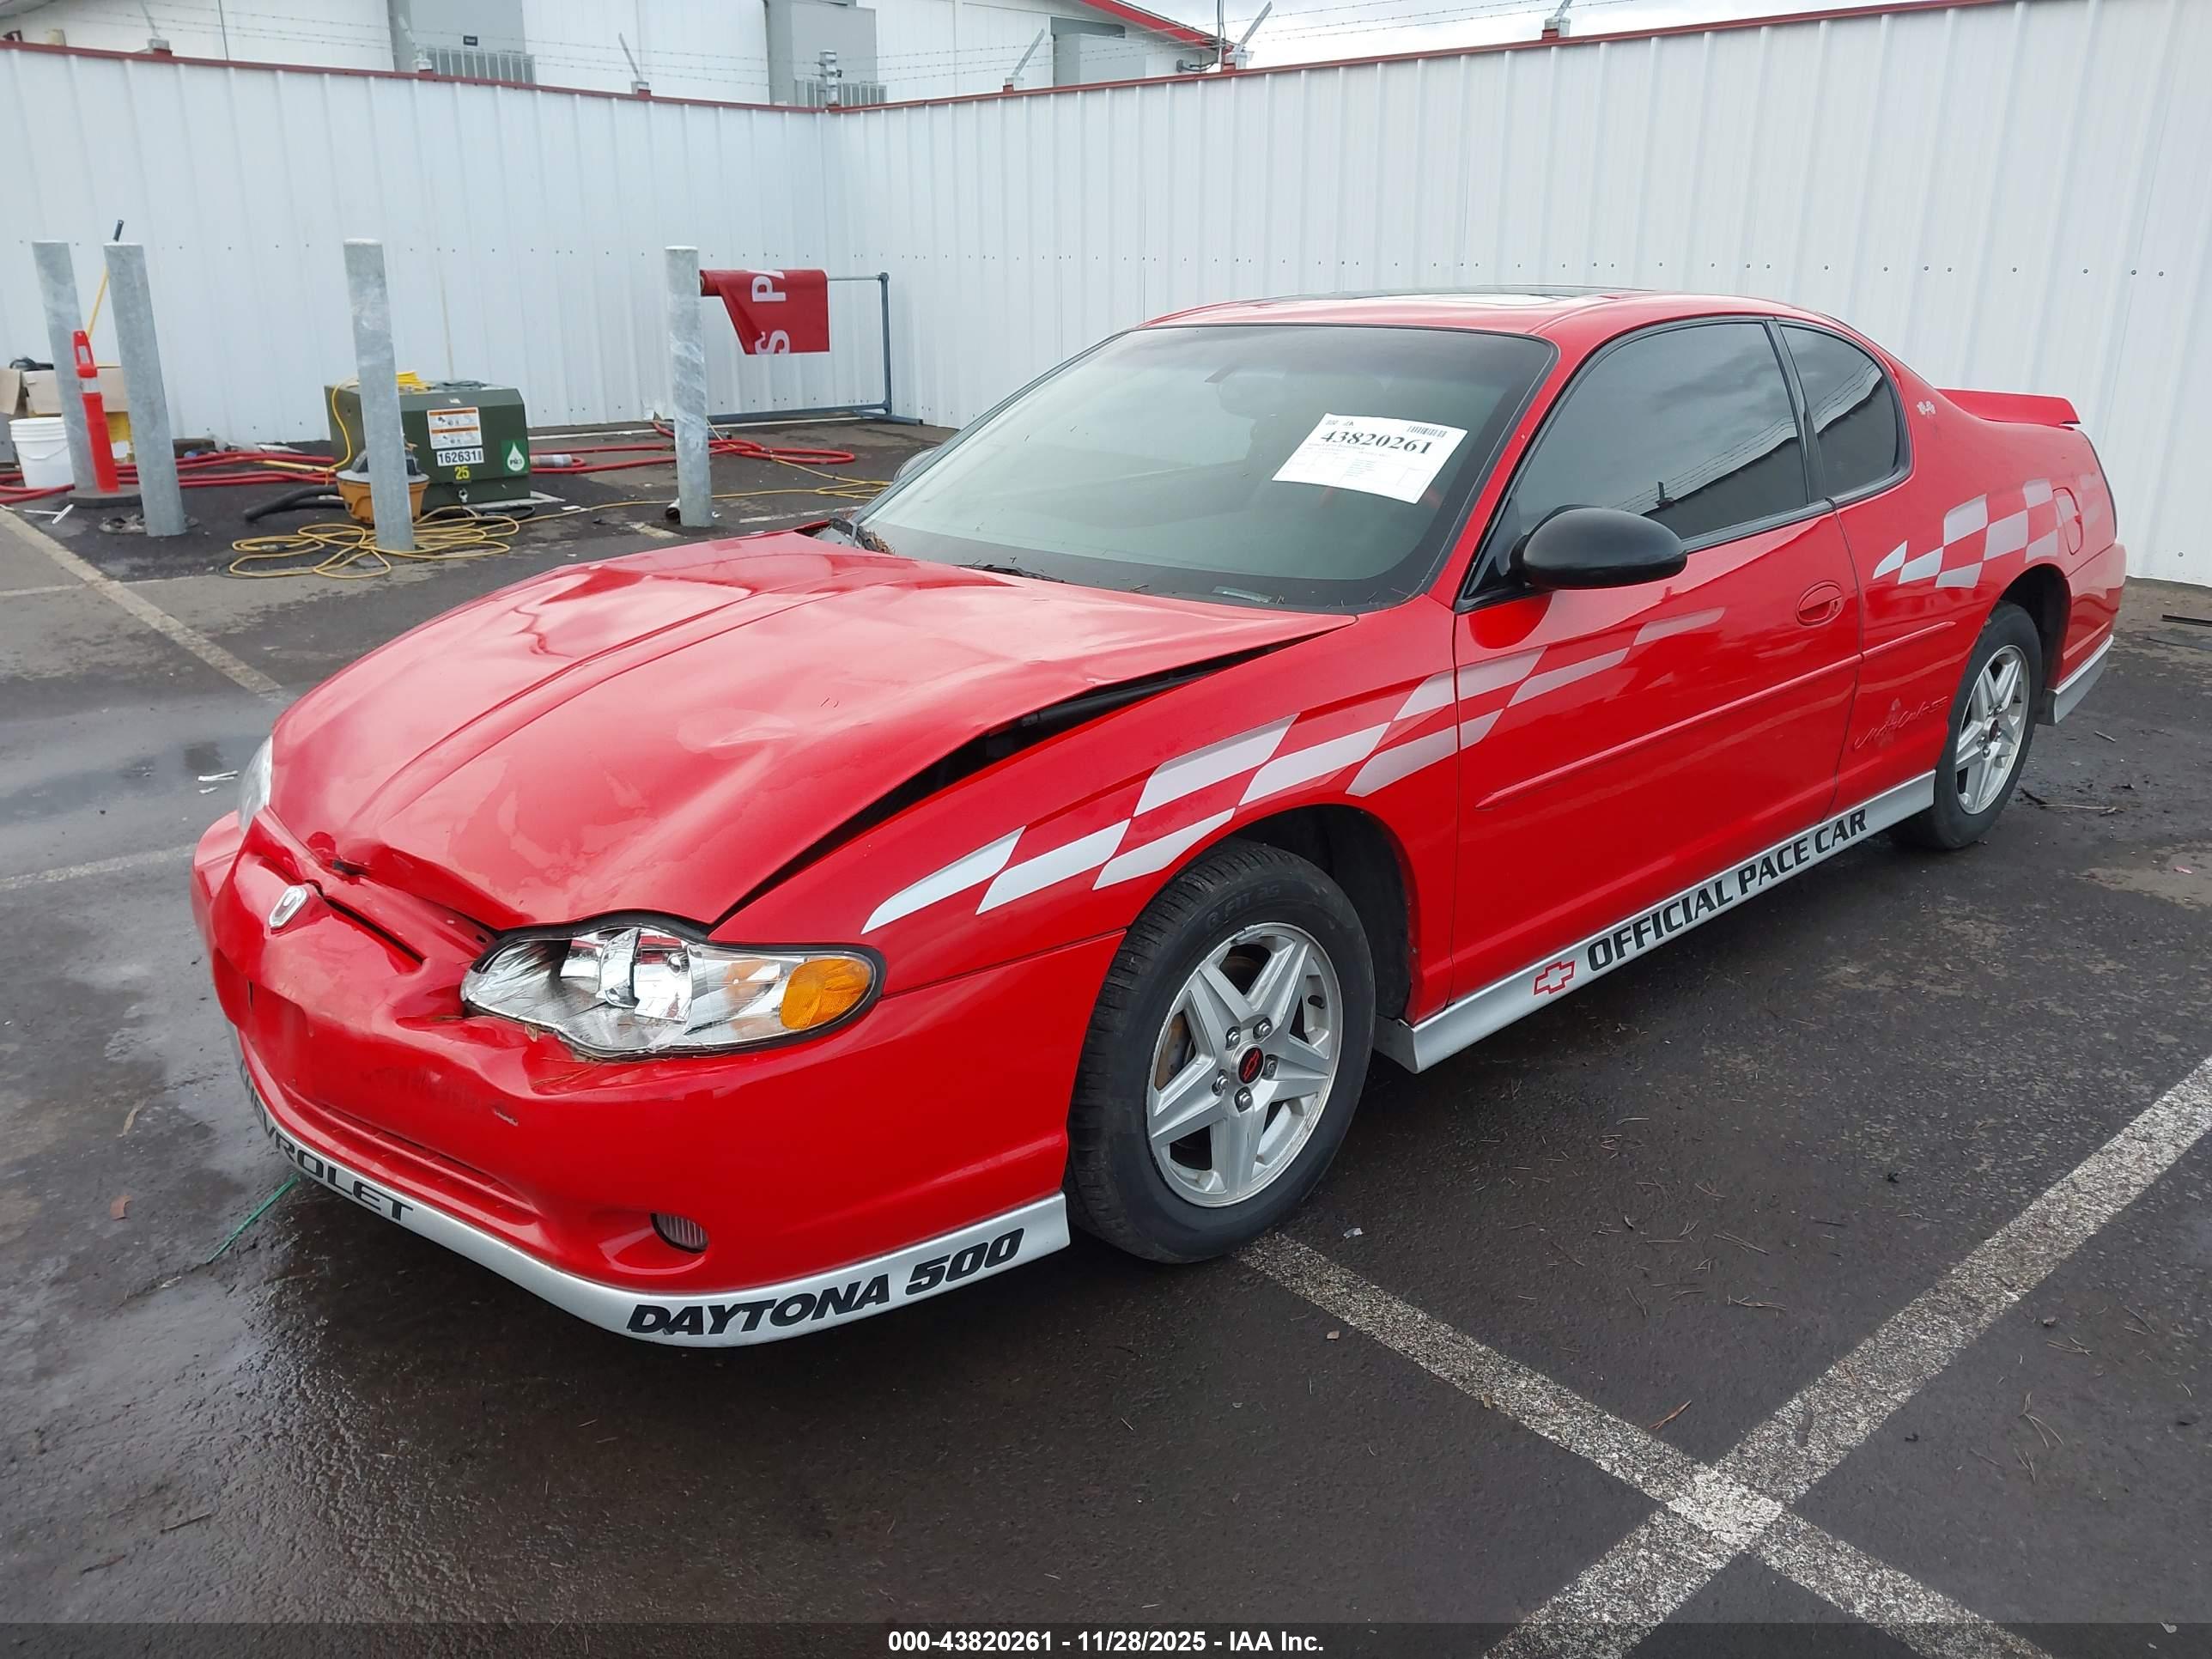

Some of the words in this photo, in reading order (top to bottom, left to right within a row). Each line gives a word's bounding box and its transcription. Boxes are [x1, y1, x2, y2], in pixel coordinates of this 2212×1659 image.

[1321, 430, 1434, 454] 43820261
[439, 450, 477, 464] 162631
[454, 465, 471, 479] 25
[1588, 880, 1733, 972] OFFICIAL
[1737, 843, 1809, 895] PACE
[1814, 809, 1868, 854] CAR
[626, 1274, 890, 1336] DAYTONA
[905, 1228, 1025, 1295] 500
